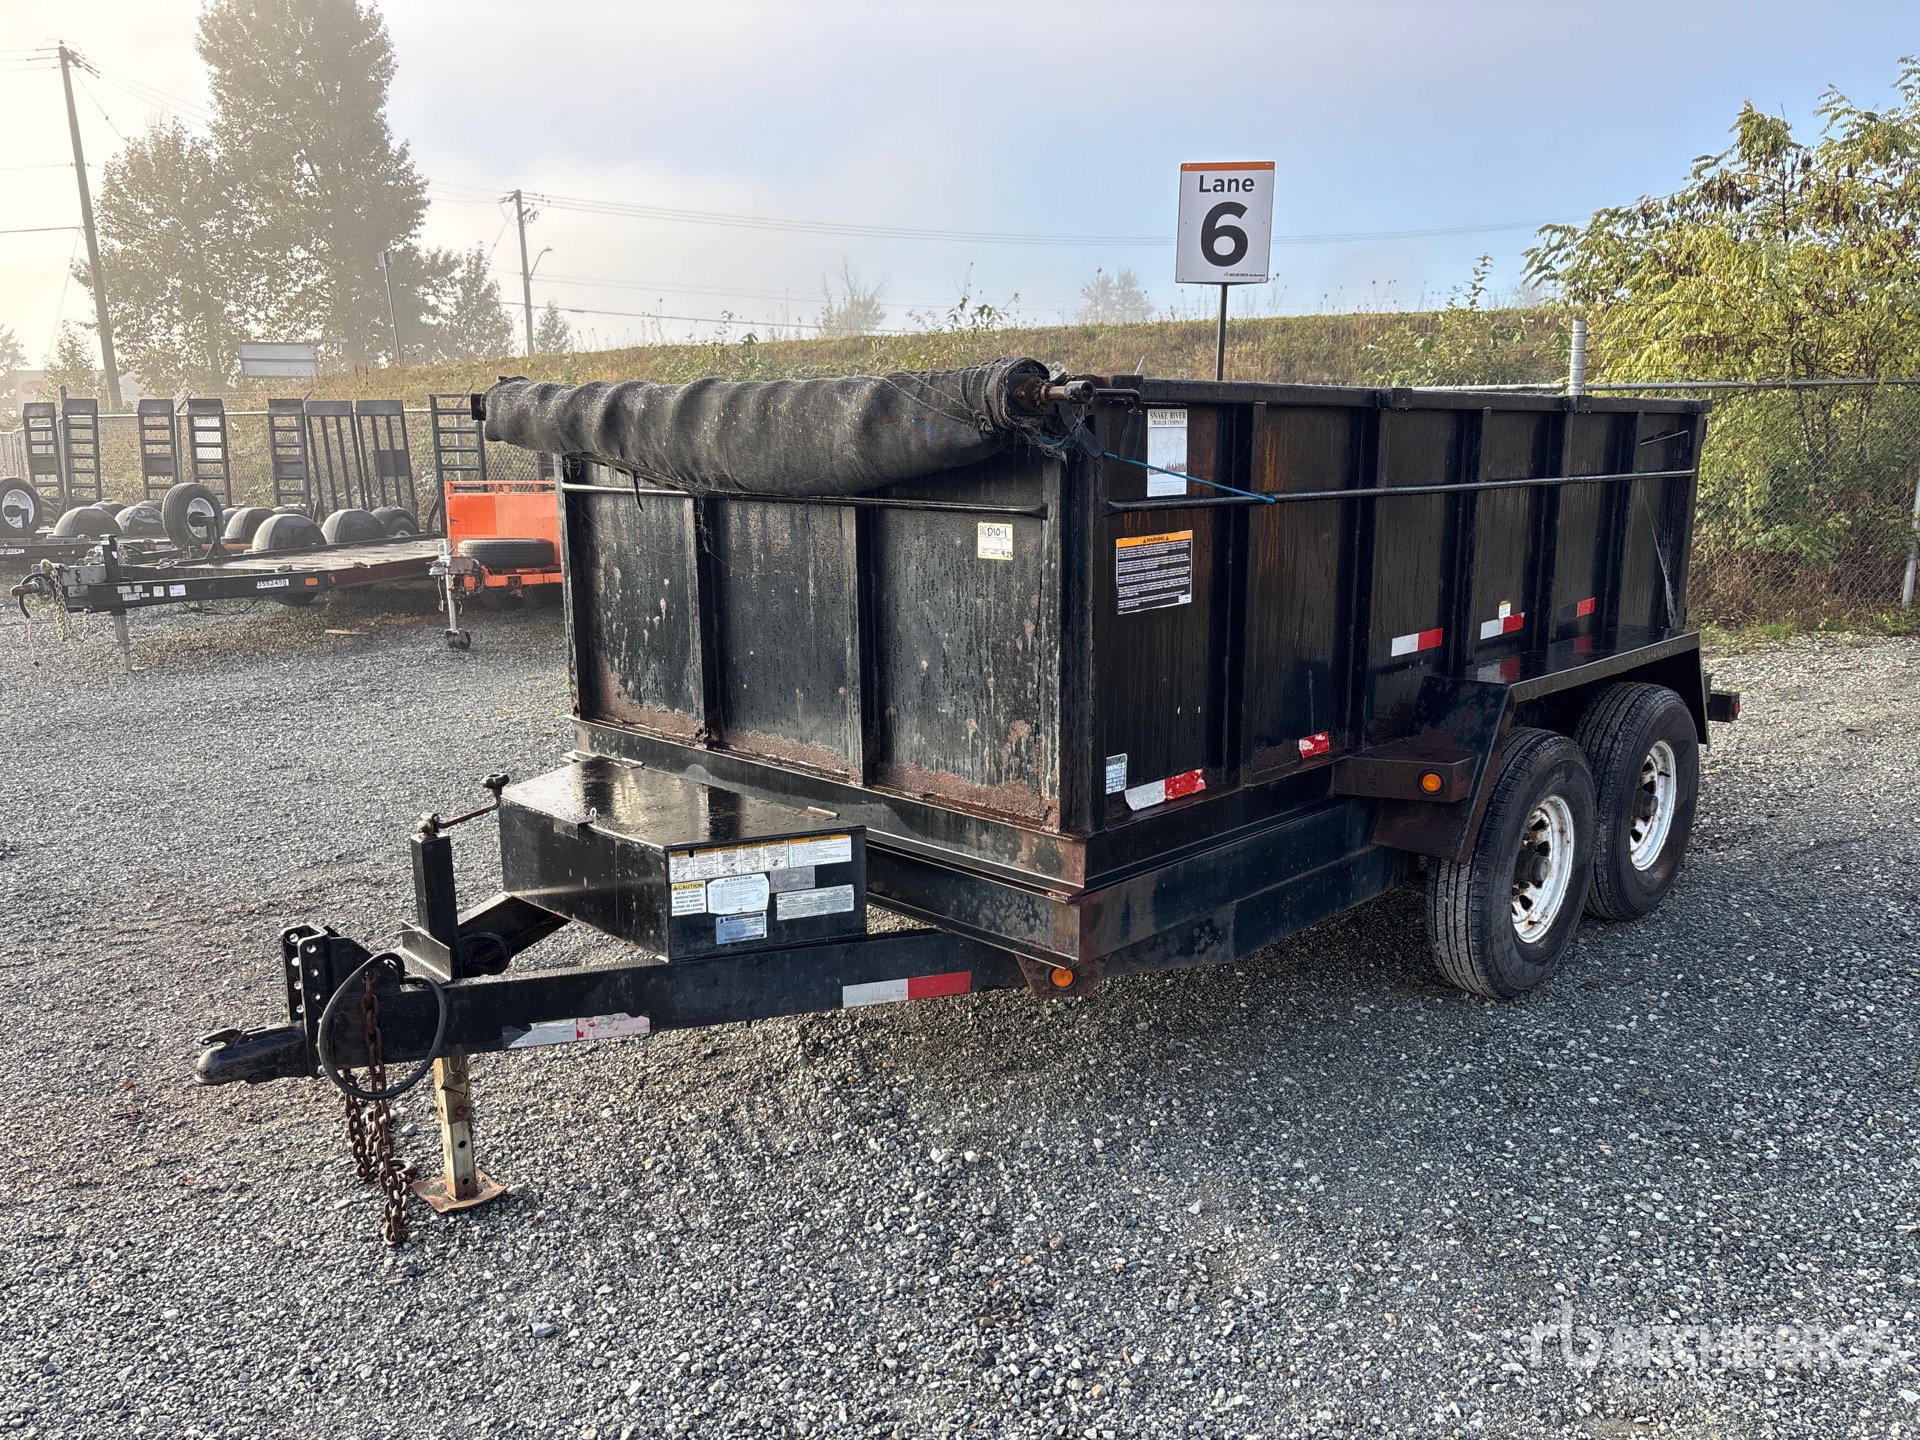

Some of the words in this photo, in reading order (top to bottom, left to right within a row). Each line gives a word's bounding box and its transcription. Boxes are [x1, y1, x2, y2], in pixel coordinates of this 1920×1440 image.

[1199, 174, 1255, 193] Lane
[1200, 201, 1248, 267] 6
[1149, 411, 1168, 420] SNAKE
[1169, 411, 1187, 420] RIVER
